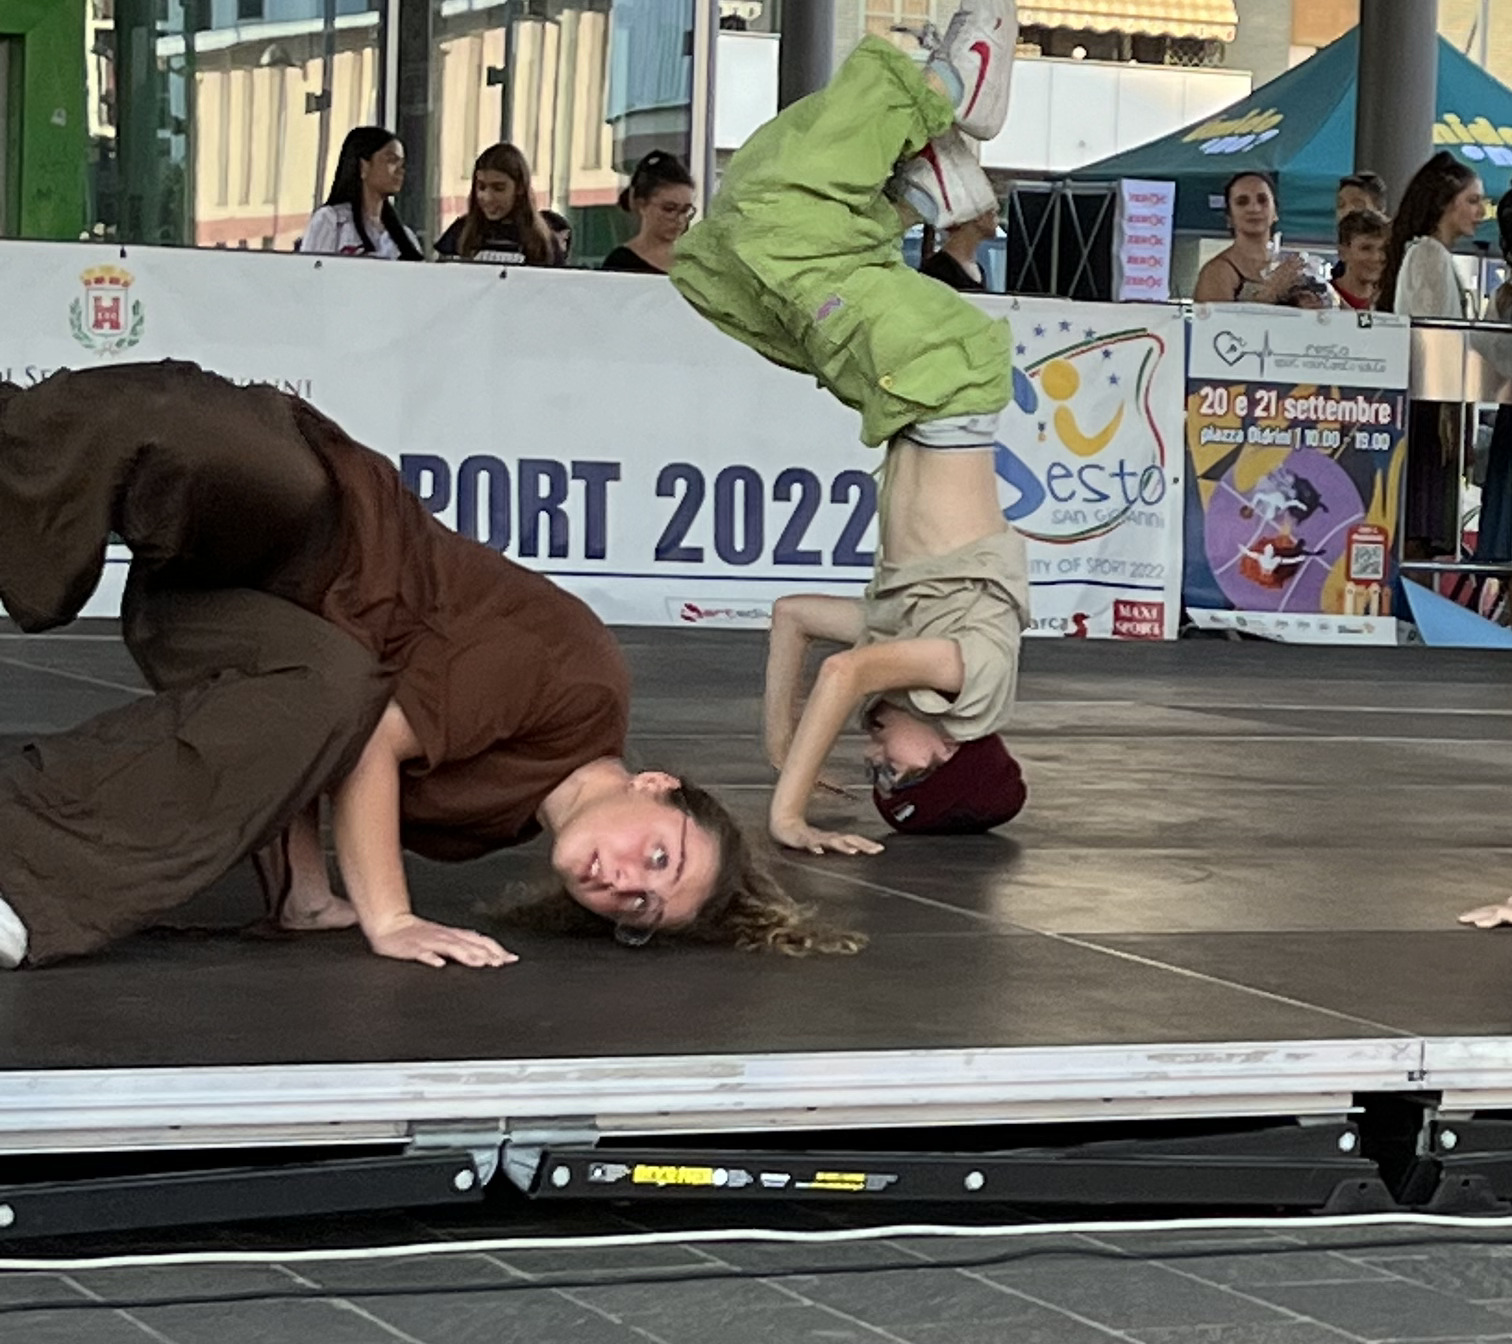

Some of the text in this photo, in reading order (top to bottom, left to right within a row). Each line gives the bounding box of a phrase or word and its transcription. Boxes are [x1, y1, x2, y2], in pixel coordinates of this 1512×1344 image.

[1200, 387, 1392, 423] 20 e 21 settembre
[1201, 426, 1243, 444] piazza
[400, 454, 881, 568] PORT 2022
[1030, 557, 1165, 578] ITY OF SPORT 2022
[1030, 616, 1069, 631] arca
